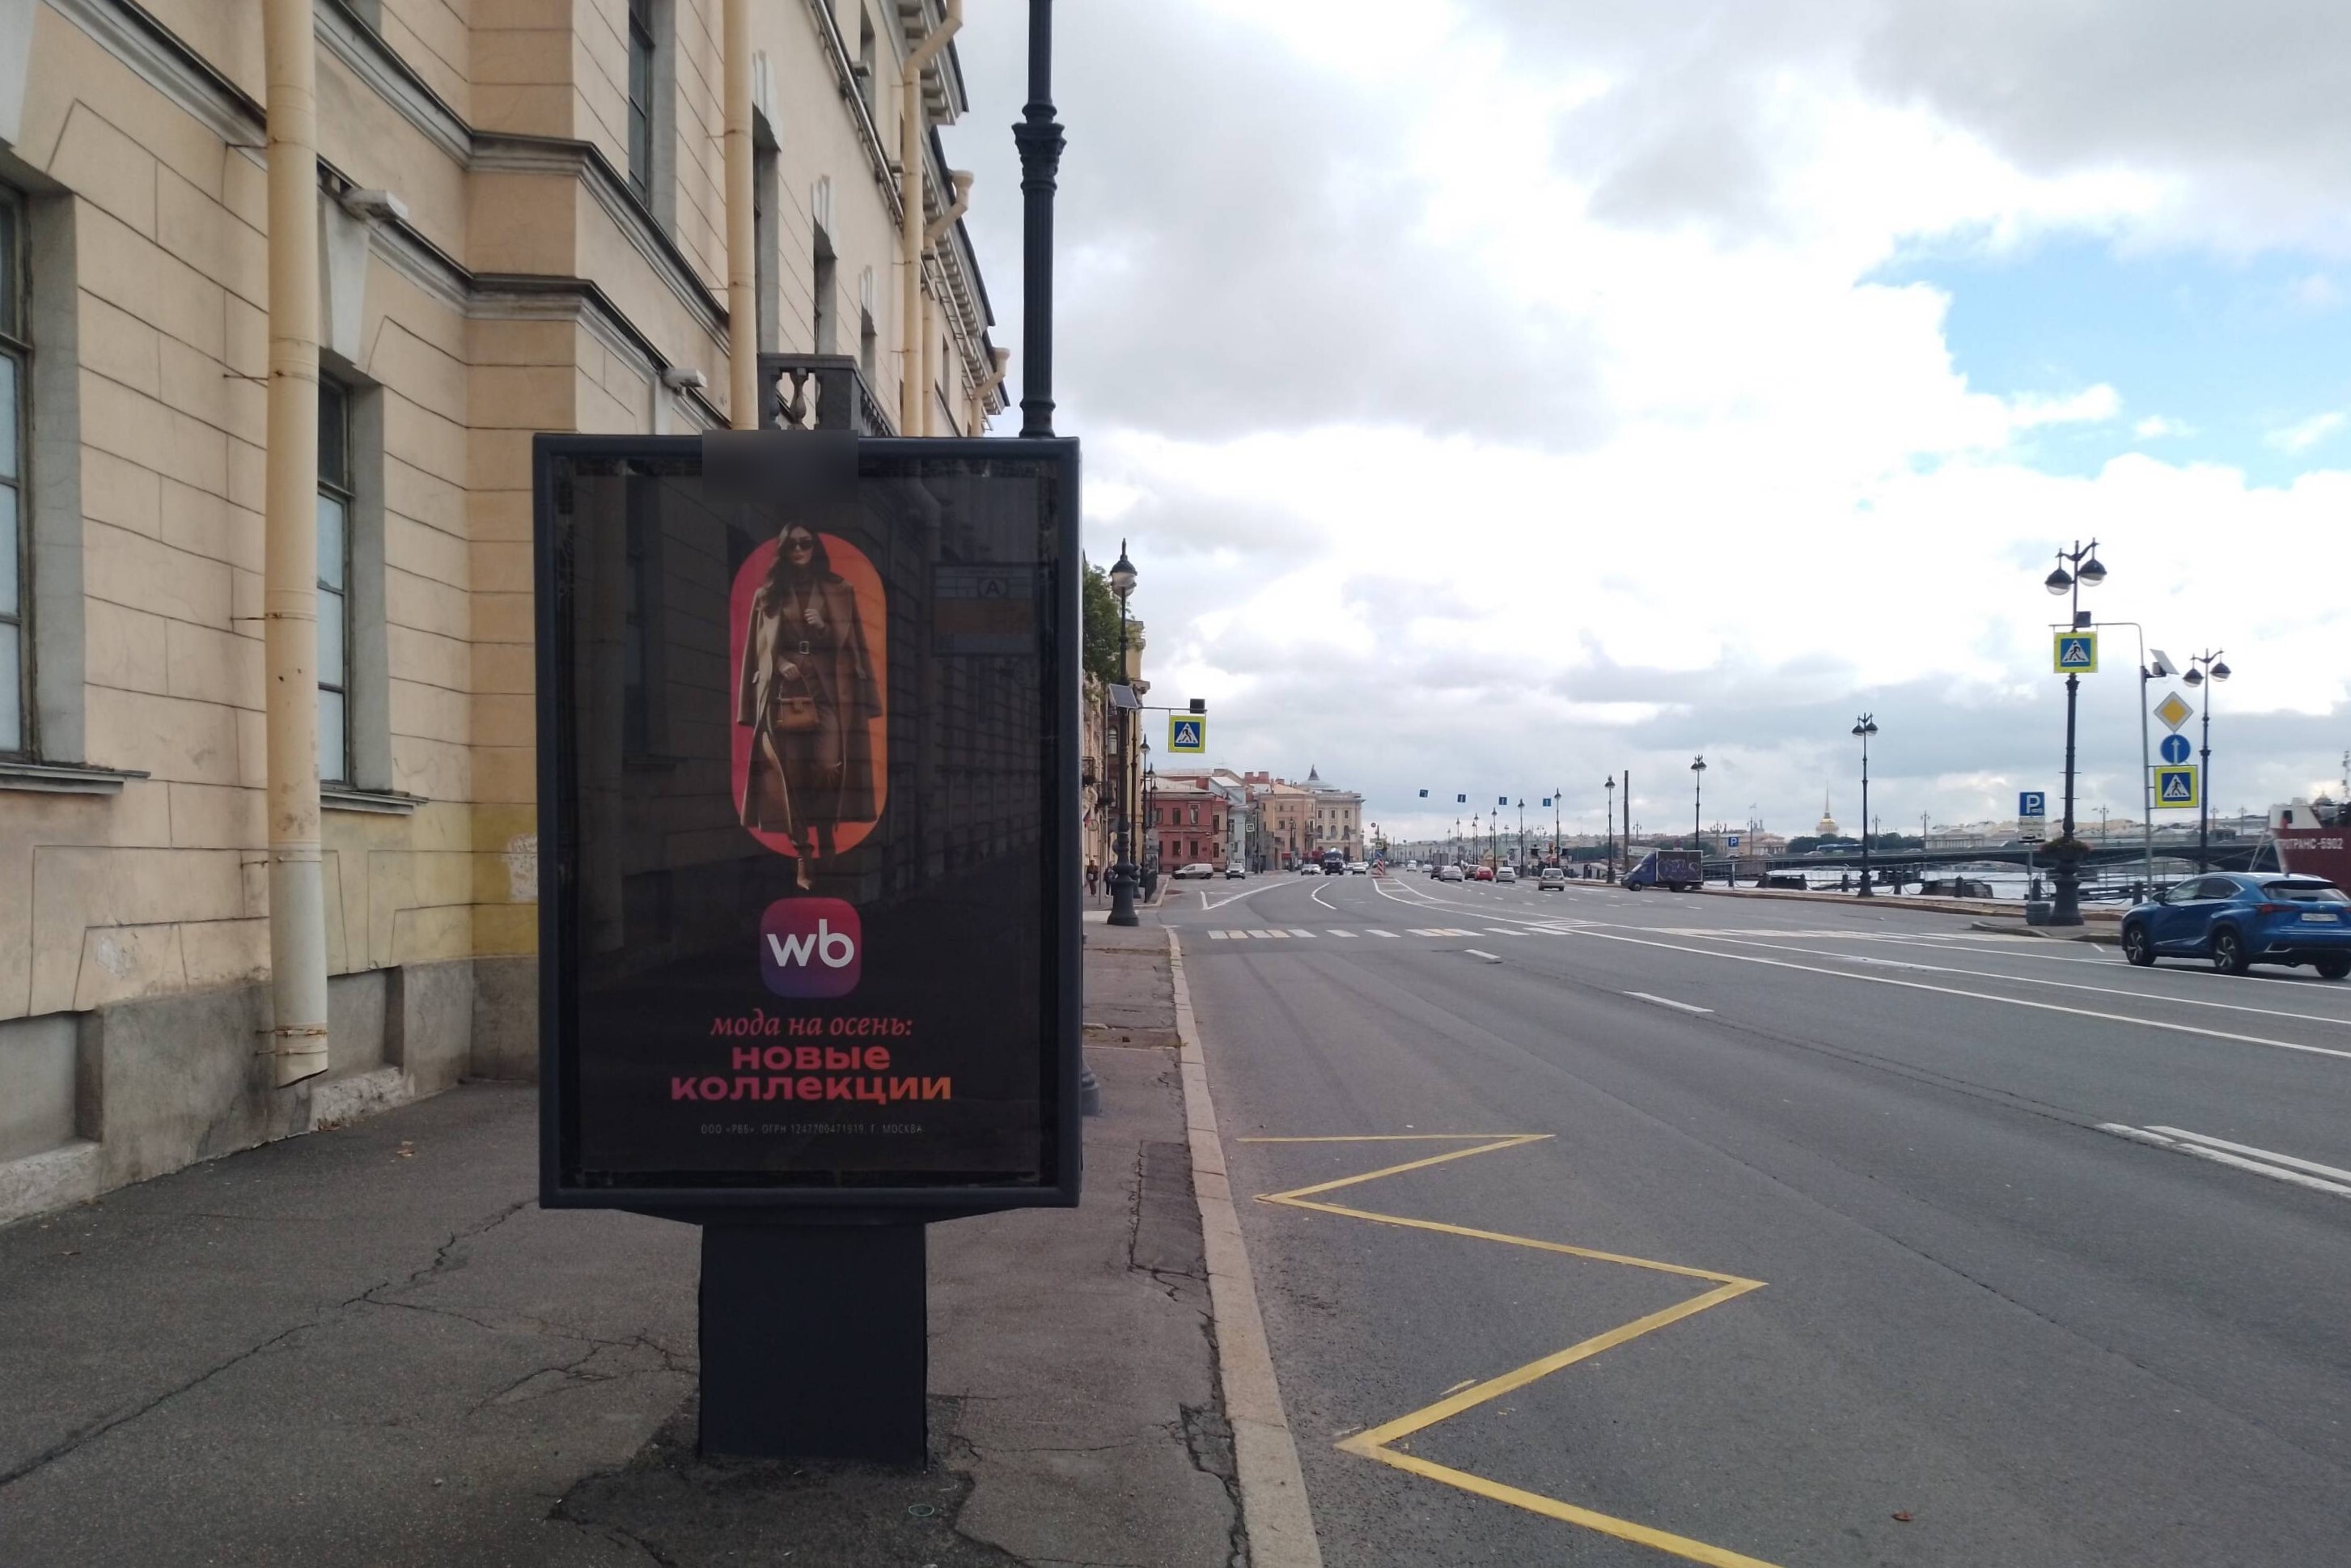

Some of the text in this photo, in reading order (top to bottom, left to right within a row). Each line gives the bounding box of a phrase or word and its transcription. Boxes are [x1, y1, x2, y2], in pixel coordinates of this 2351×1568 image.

[766, 918, 855, 968] wb
[710, 1008, 913, 1036] мода на осень:
[732, 1045, 891, 1070] новые
[671, 1076, 951, 1105] коллекции
[701, 1123, 722, 1134] ООО
[761, 1123, 787, 1134] ОГРН
